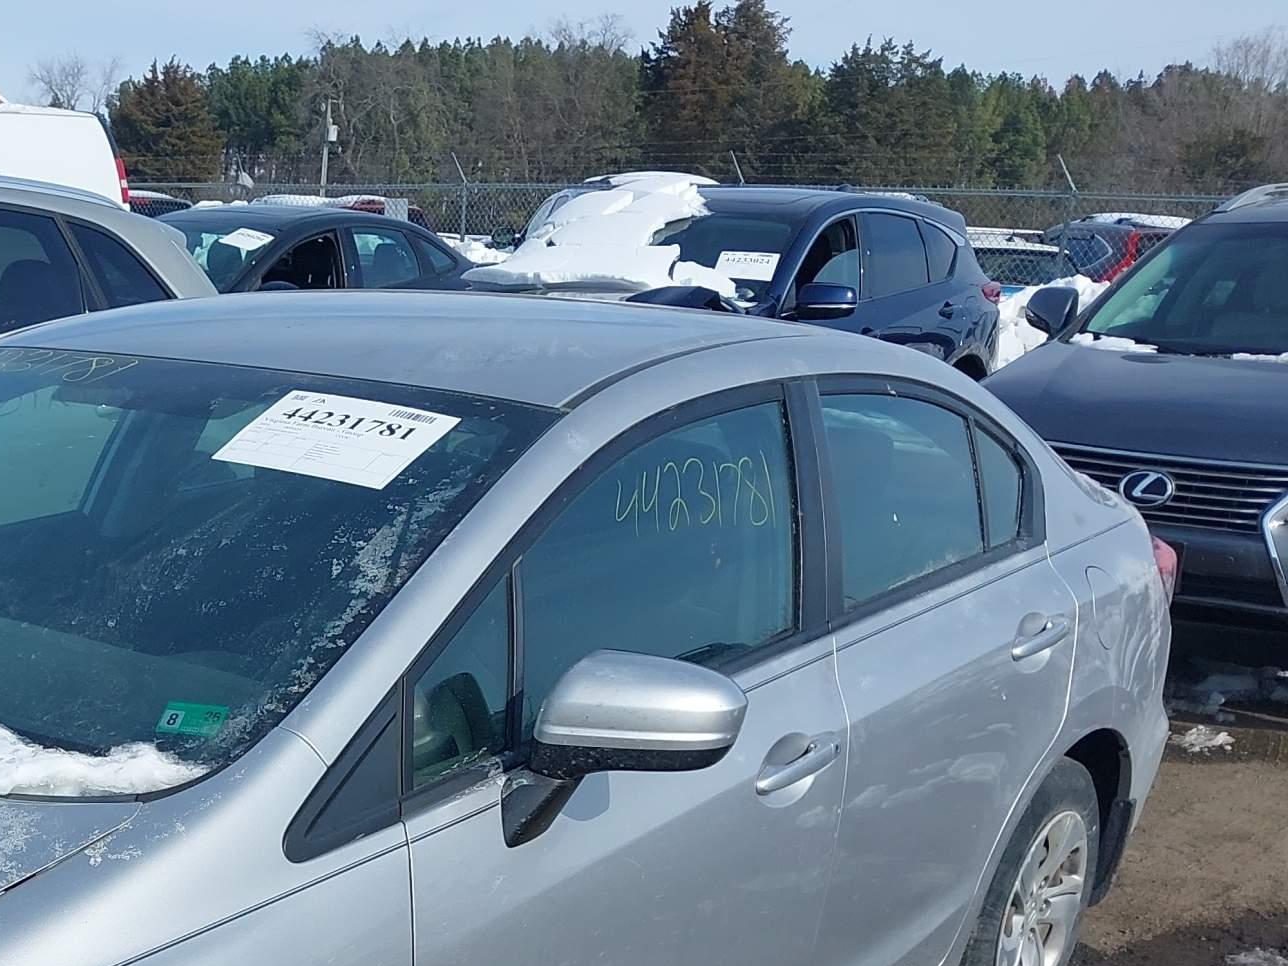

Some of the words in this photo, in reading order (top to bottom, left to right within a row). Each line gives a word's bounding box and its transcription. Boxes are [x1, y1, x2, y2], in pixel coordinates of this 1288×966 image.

[280, 405, 418, 442] 44231781
[614, 449, 777, 537] 44231781
[166, 712, 180, 726] 8
